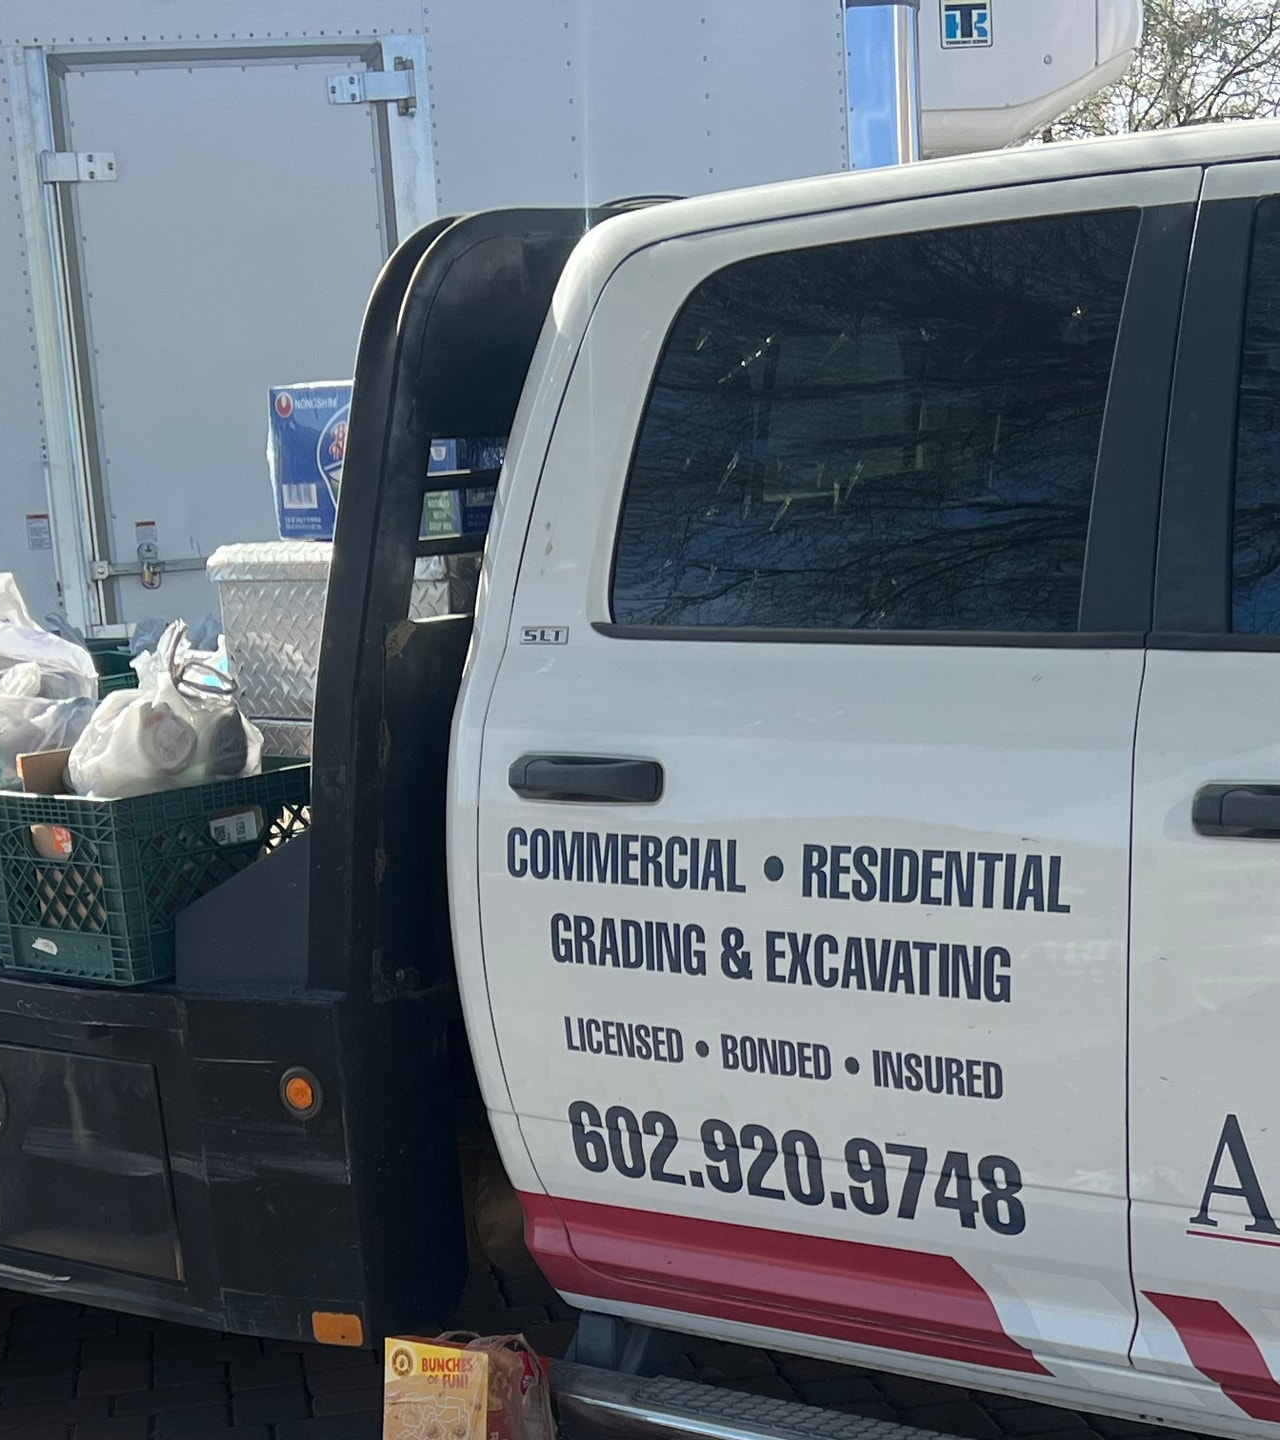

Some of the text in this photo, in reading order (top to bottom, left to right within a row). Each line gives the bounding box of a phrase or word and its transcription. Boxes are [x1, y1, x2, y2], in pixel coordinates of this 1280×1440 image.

[523, 629, 564, 642] SLT
[506, 826, 1072, 914] COMMERCIAL RESIDENTIAL
[550, 912, 1013, 1004] GRADING & EXCAVATING
[564, 1015, 1004, 1100] LICENSED BONDED INSURED
[568, 1099, 1027, 1237] 602.920.9748
[421, 1357, 473, 1374] BUNCHES
[427, 1374, 469, 1389] OF FUN!
